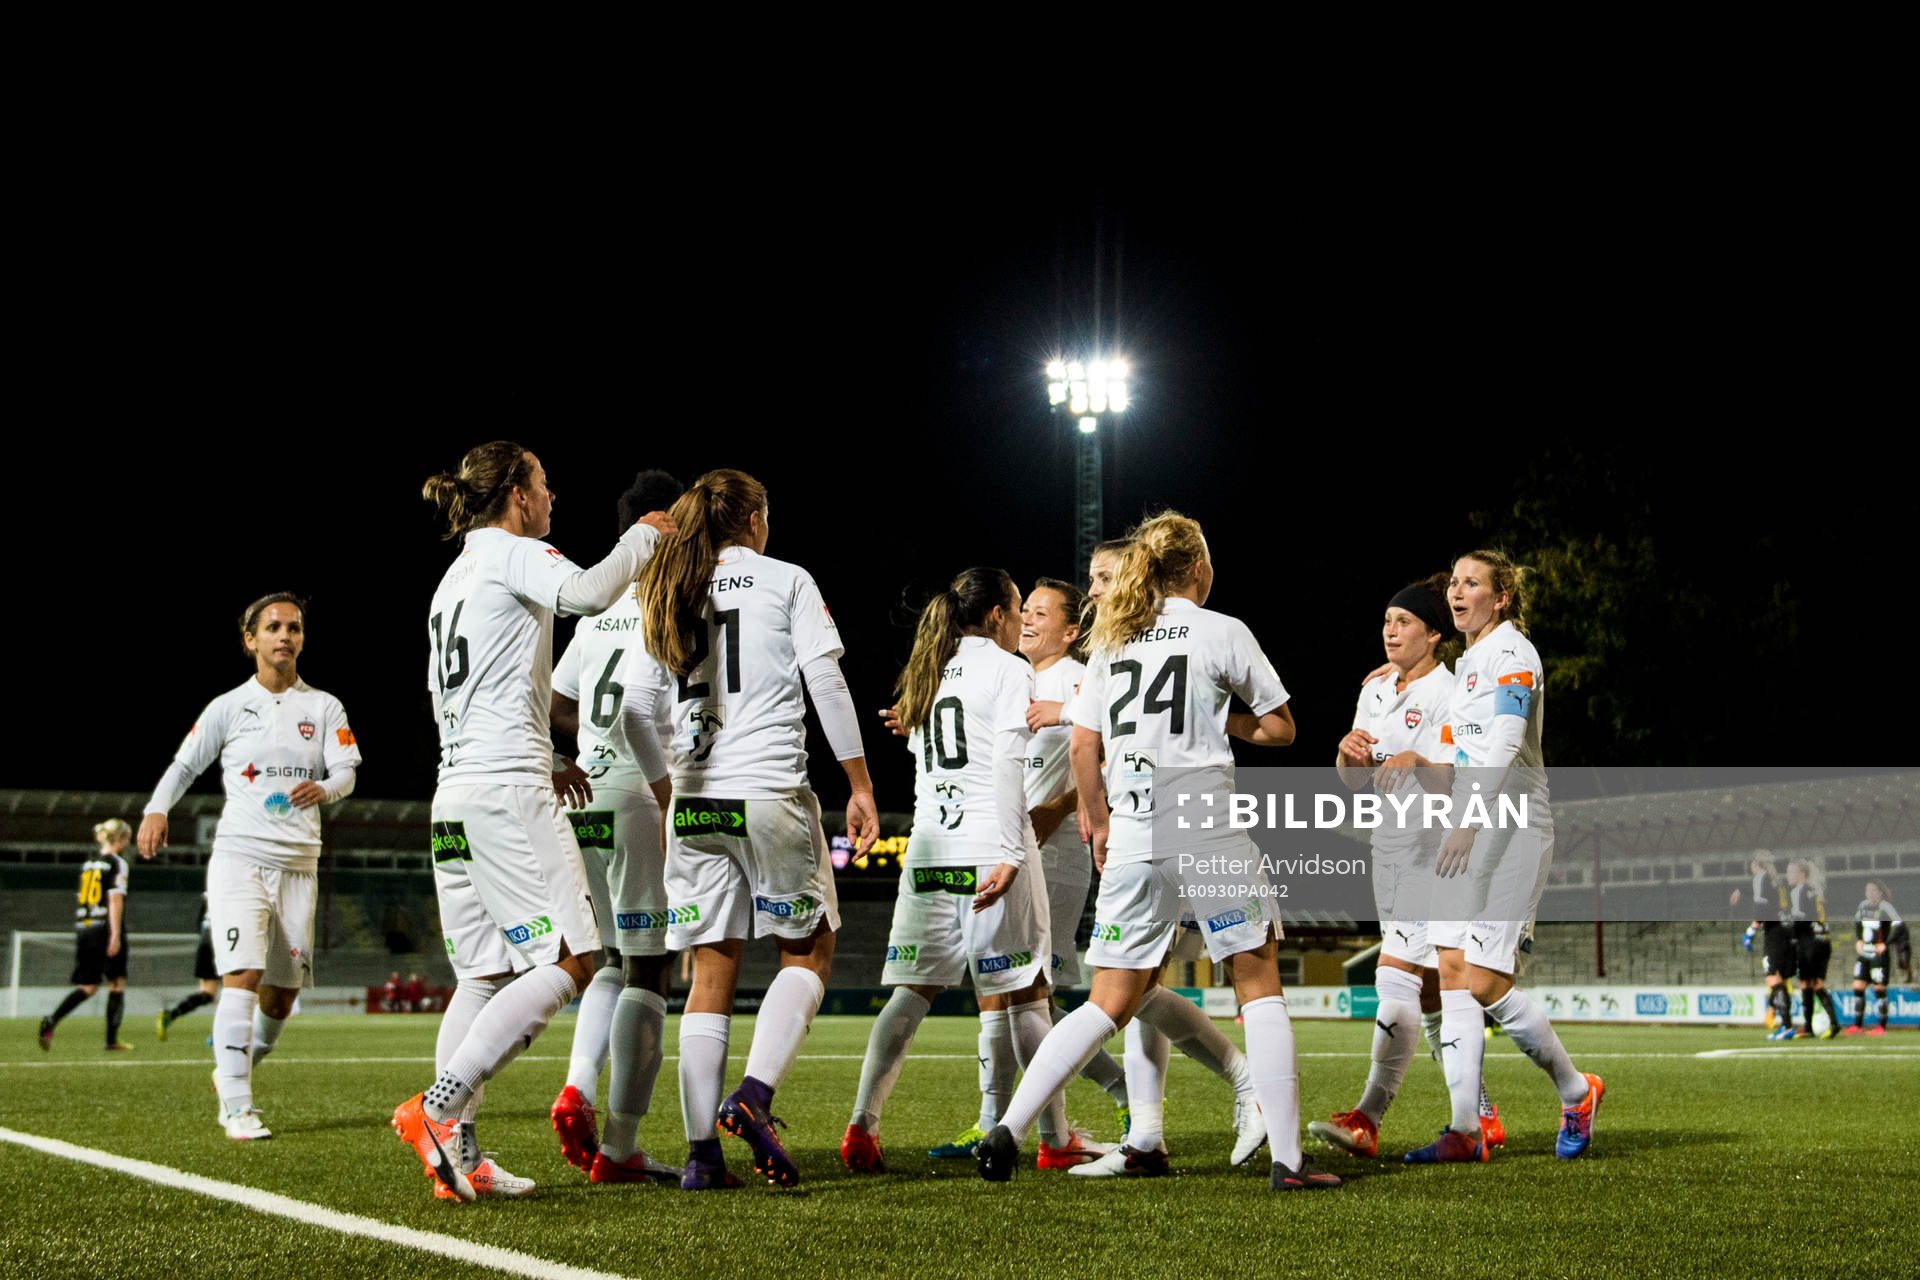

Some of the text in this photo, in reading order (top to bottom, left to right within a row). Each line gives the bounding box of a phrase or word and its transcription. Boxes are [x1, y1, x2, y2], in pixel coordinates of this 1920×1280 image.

[708, 575, 754, 594] TENS
[593, 617, 640, 632] ASANT
[431, 598, 470, 696] 16
[677, 608, 741, 704] 21
[942, 666, 963, 681] RTA
[590, 648, 625, 729] 6
[1109, 654, 1188, 740] 24
[922, 695, 969, 774] 10
[675, 807, 722, 827] akea
[573, 825, 598, 839] ea
[916, 869, 954, 885] akea
[79, 869, 103, 905] 16
[761, 899, 787, 915] MKB
[619, 914, 648, 927] MKB
[1213, 913, 1242, 929] MKB
[226, 927, 240, 952] 9
[981, 956, 1008, 972] MKB
